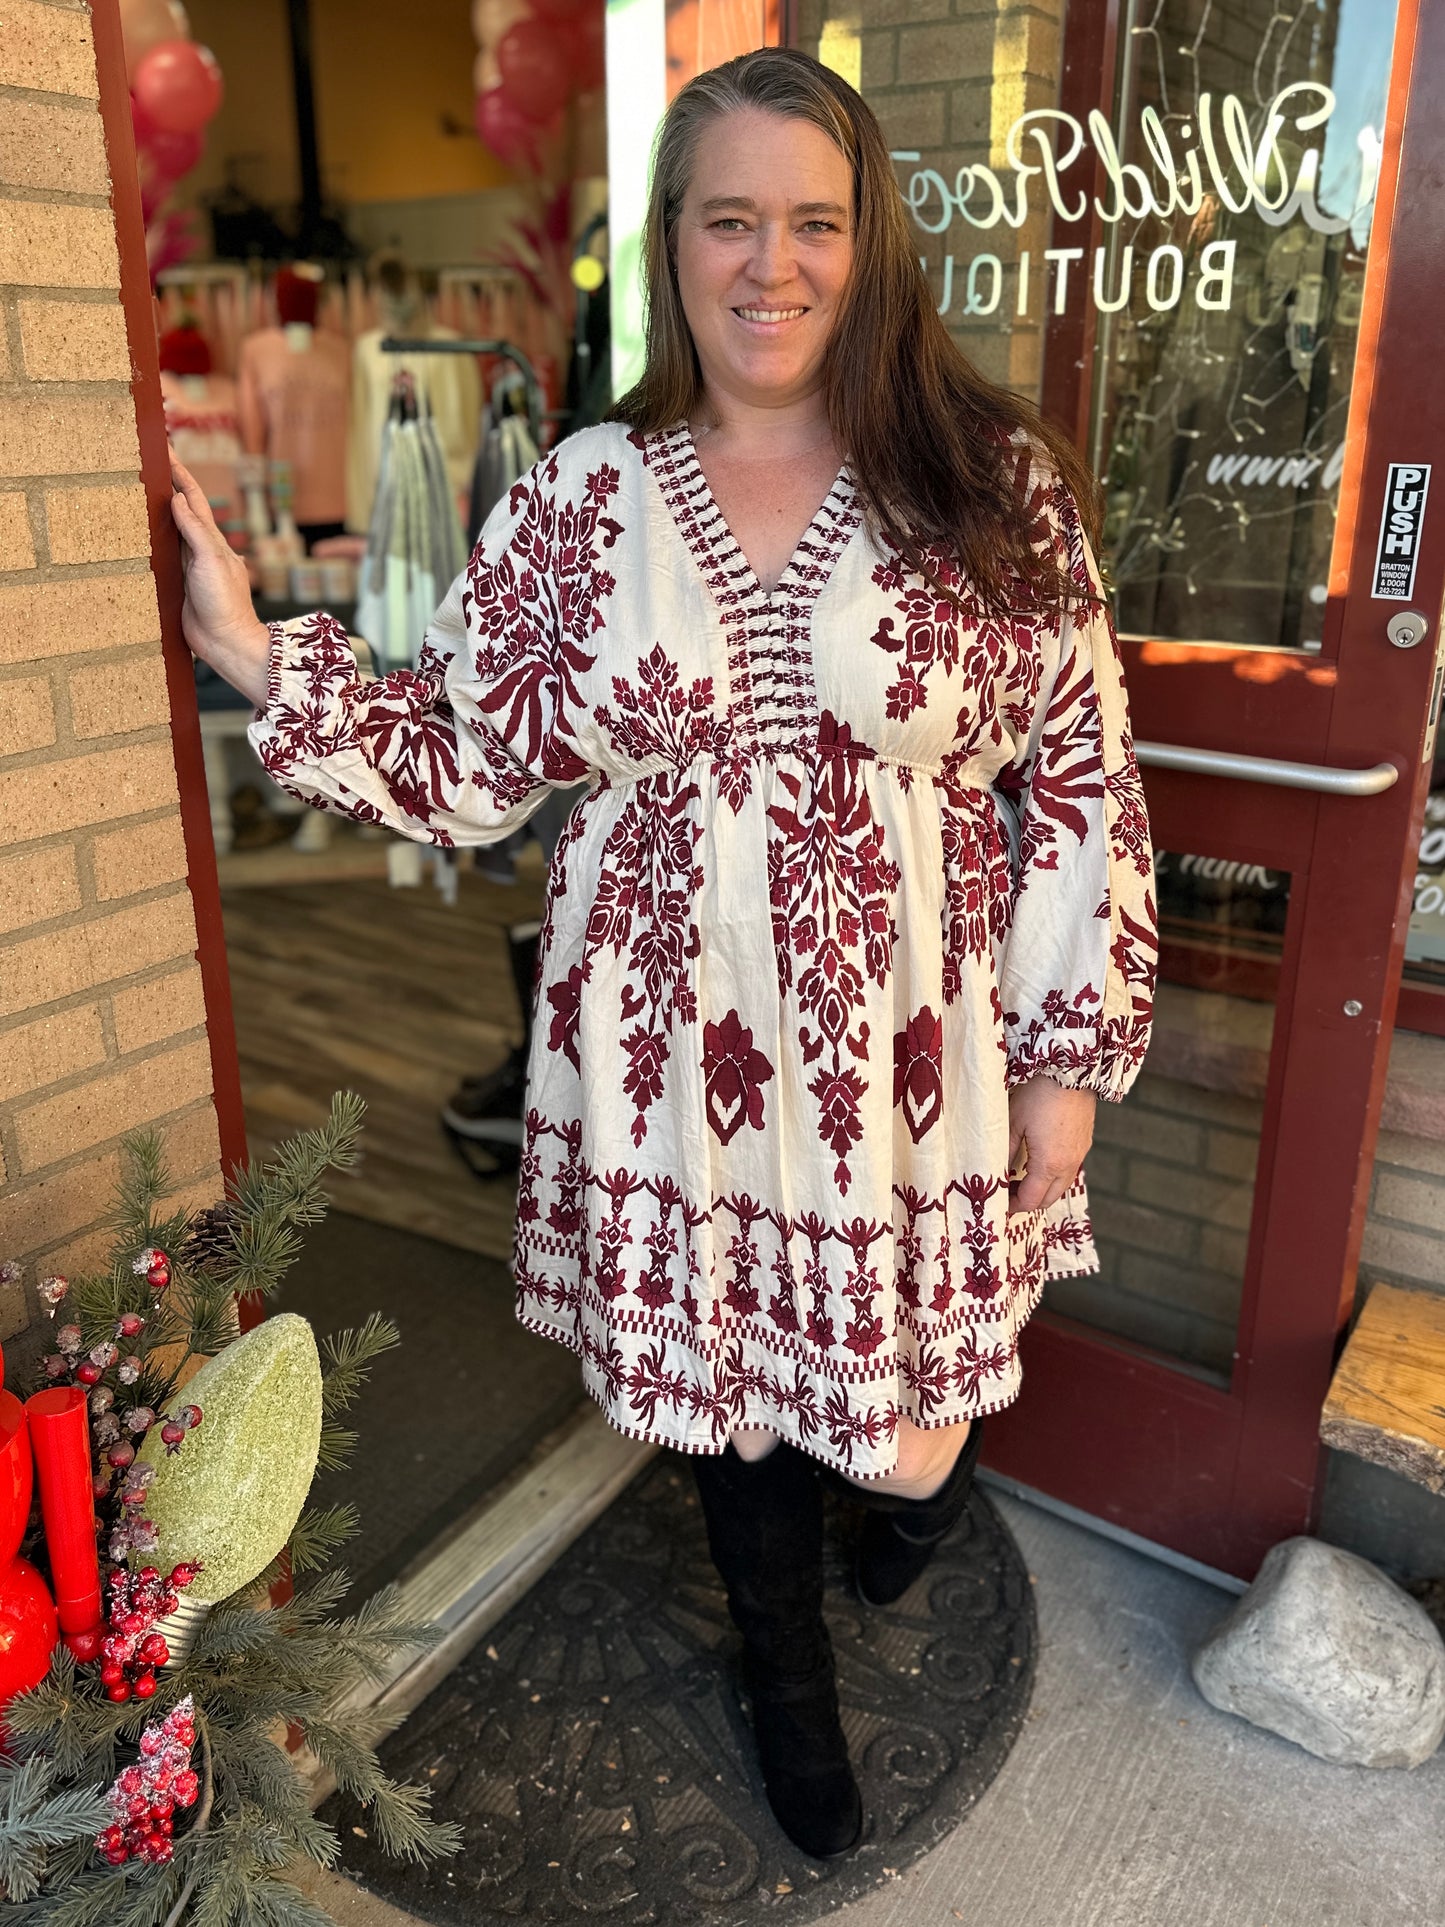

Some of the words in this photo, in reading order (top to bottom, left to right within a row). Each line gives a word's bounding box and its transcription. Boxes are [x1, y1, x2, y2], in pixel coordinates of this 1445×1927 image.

[1384, 468, 1422, 556] PUSH
[1381, 562, 1410, 571] BRATTON
[1381, 571, 1408, 579] WINDOW
[1386, 579, 1406, 587] DOOR
